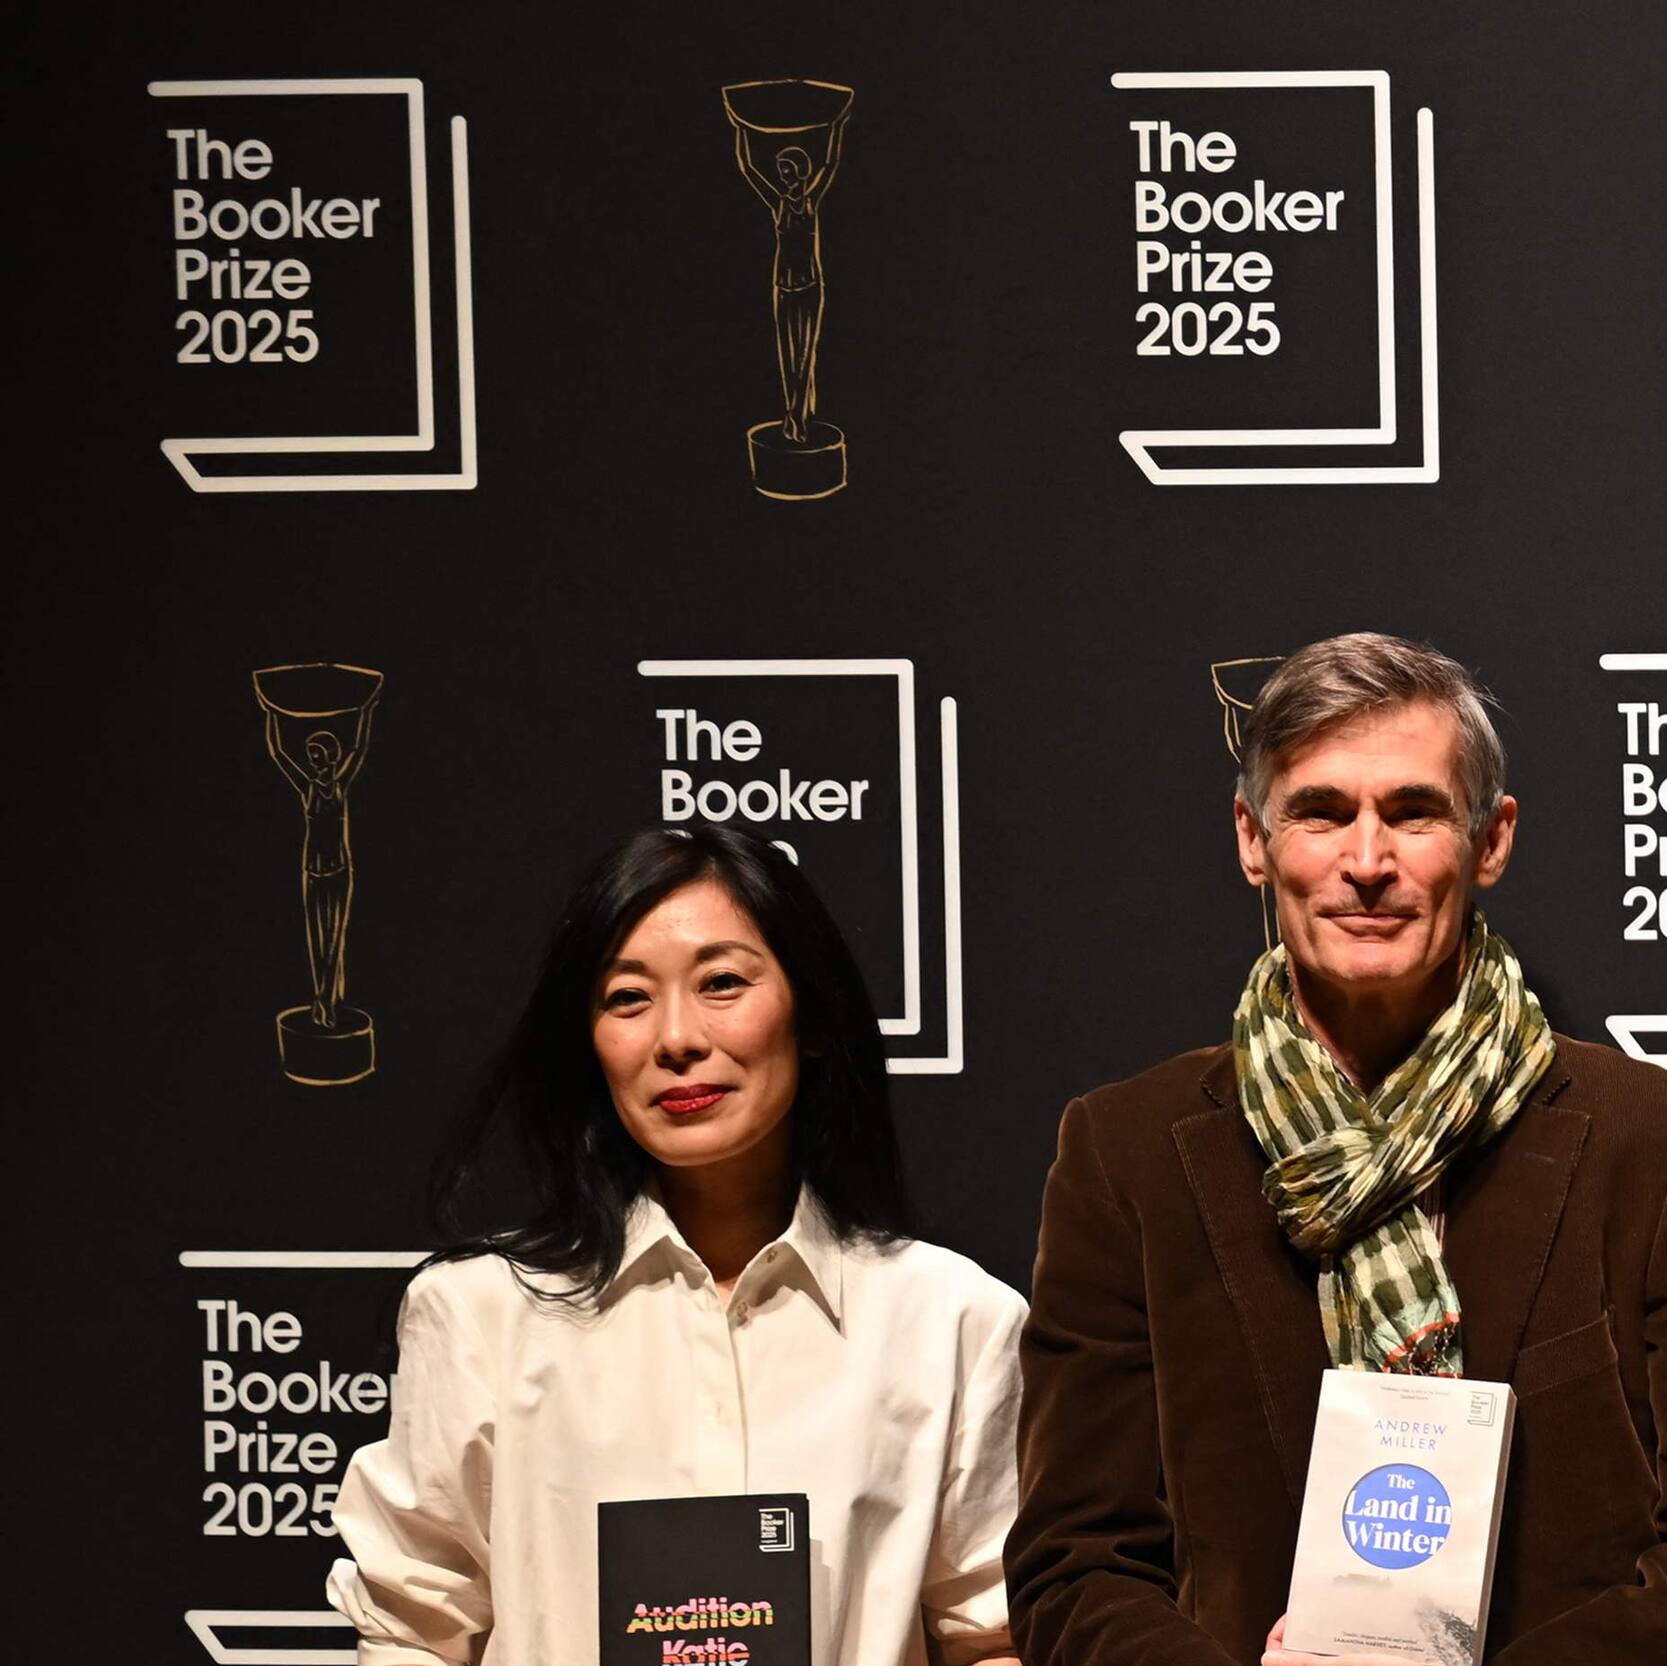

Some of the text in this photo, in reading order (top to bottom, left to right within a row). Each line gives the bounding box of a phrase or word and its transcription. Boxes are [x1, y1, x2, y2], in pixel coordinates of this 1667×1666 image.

[168, 130, 272, 179] The
[1130, 121, 1236, 172] The
[175, 188, 379, 239] Booker
[1136, 180, 1344, 233] Booker
[177, 250, 310, 299] Prize
[1137, 241, 1273, 292] Prize
[177, 310, 318, 363] 2025
[1136, 302, 1280, 356] 2025
[657, 709, 761, 761] The
[662, 769, 868, 821] Booker
[198, 1300, 302, 1353] The
[205, 1421, 337, 1473] Prize
[1374, 1419, 1448, 1436] ANDREW
[1380, 1435, 1437, 1451] MILLER
[1387, 1473, 1415, 1490] The
[203, 1483, 340, 1537] 2025
[1345, 1490, 1451, 1525] Land in
[1346, 1520, 1446, 1556] Winter
[626, 1597, 774, 1633] Audition
